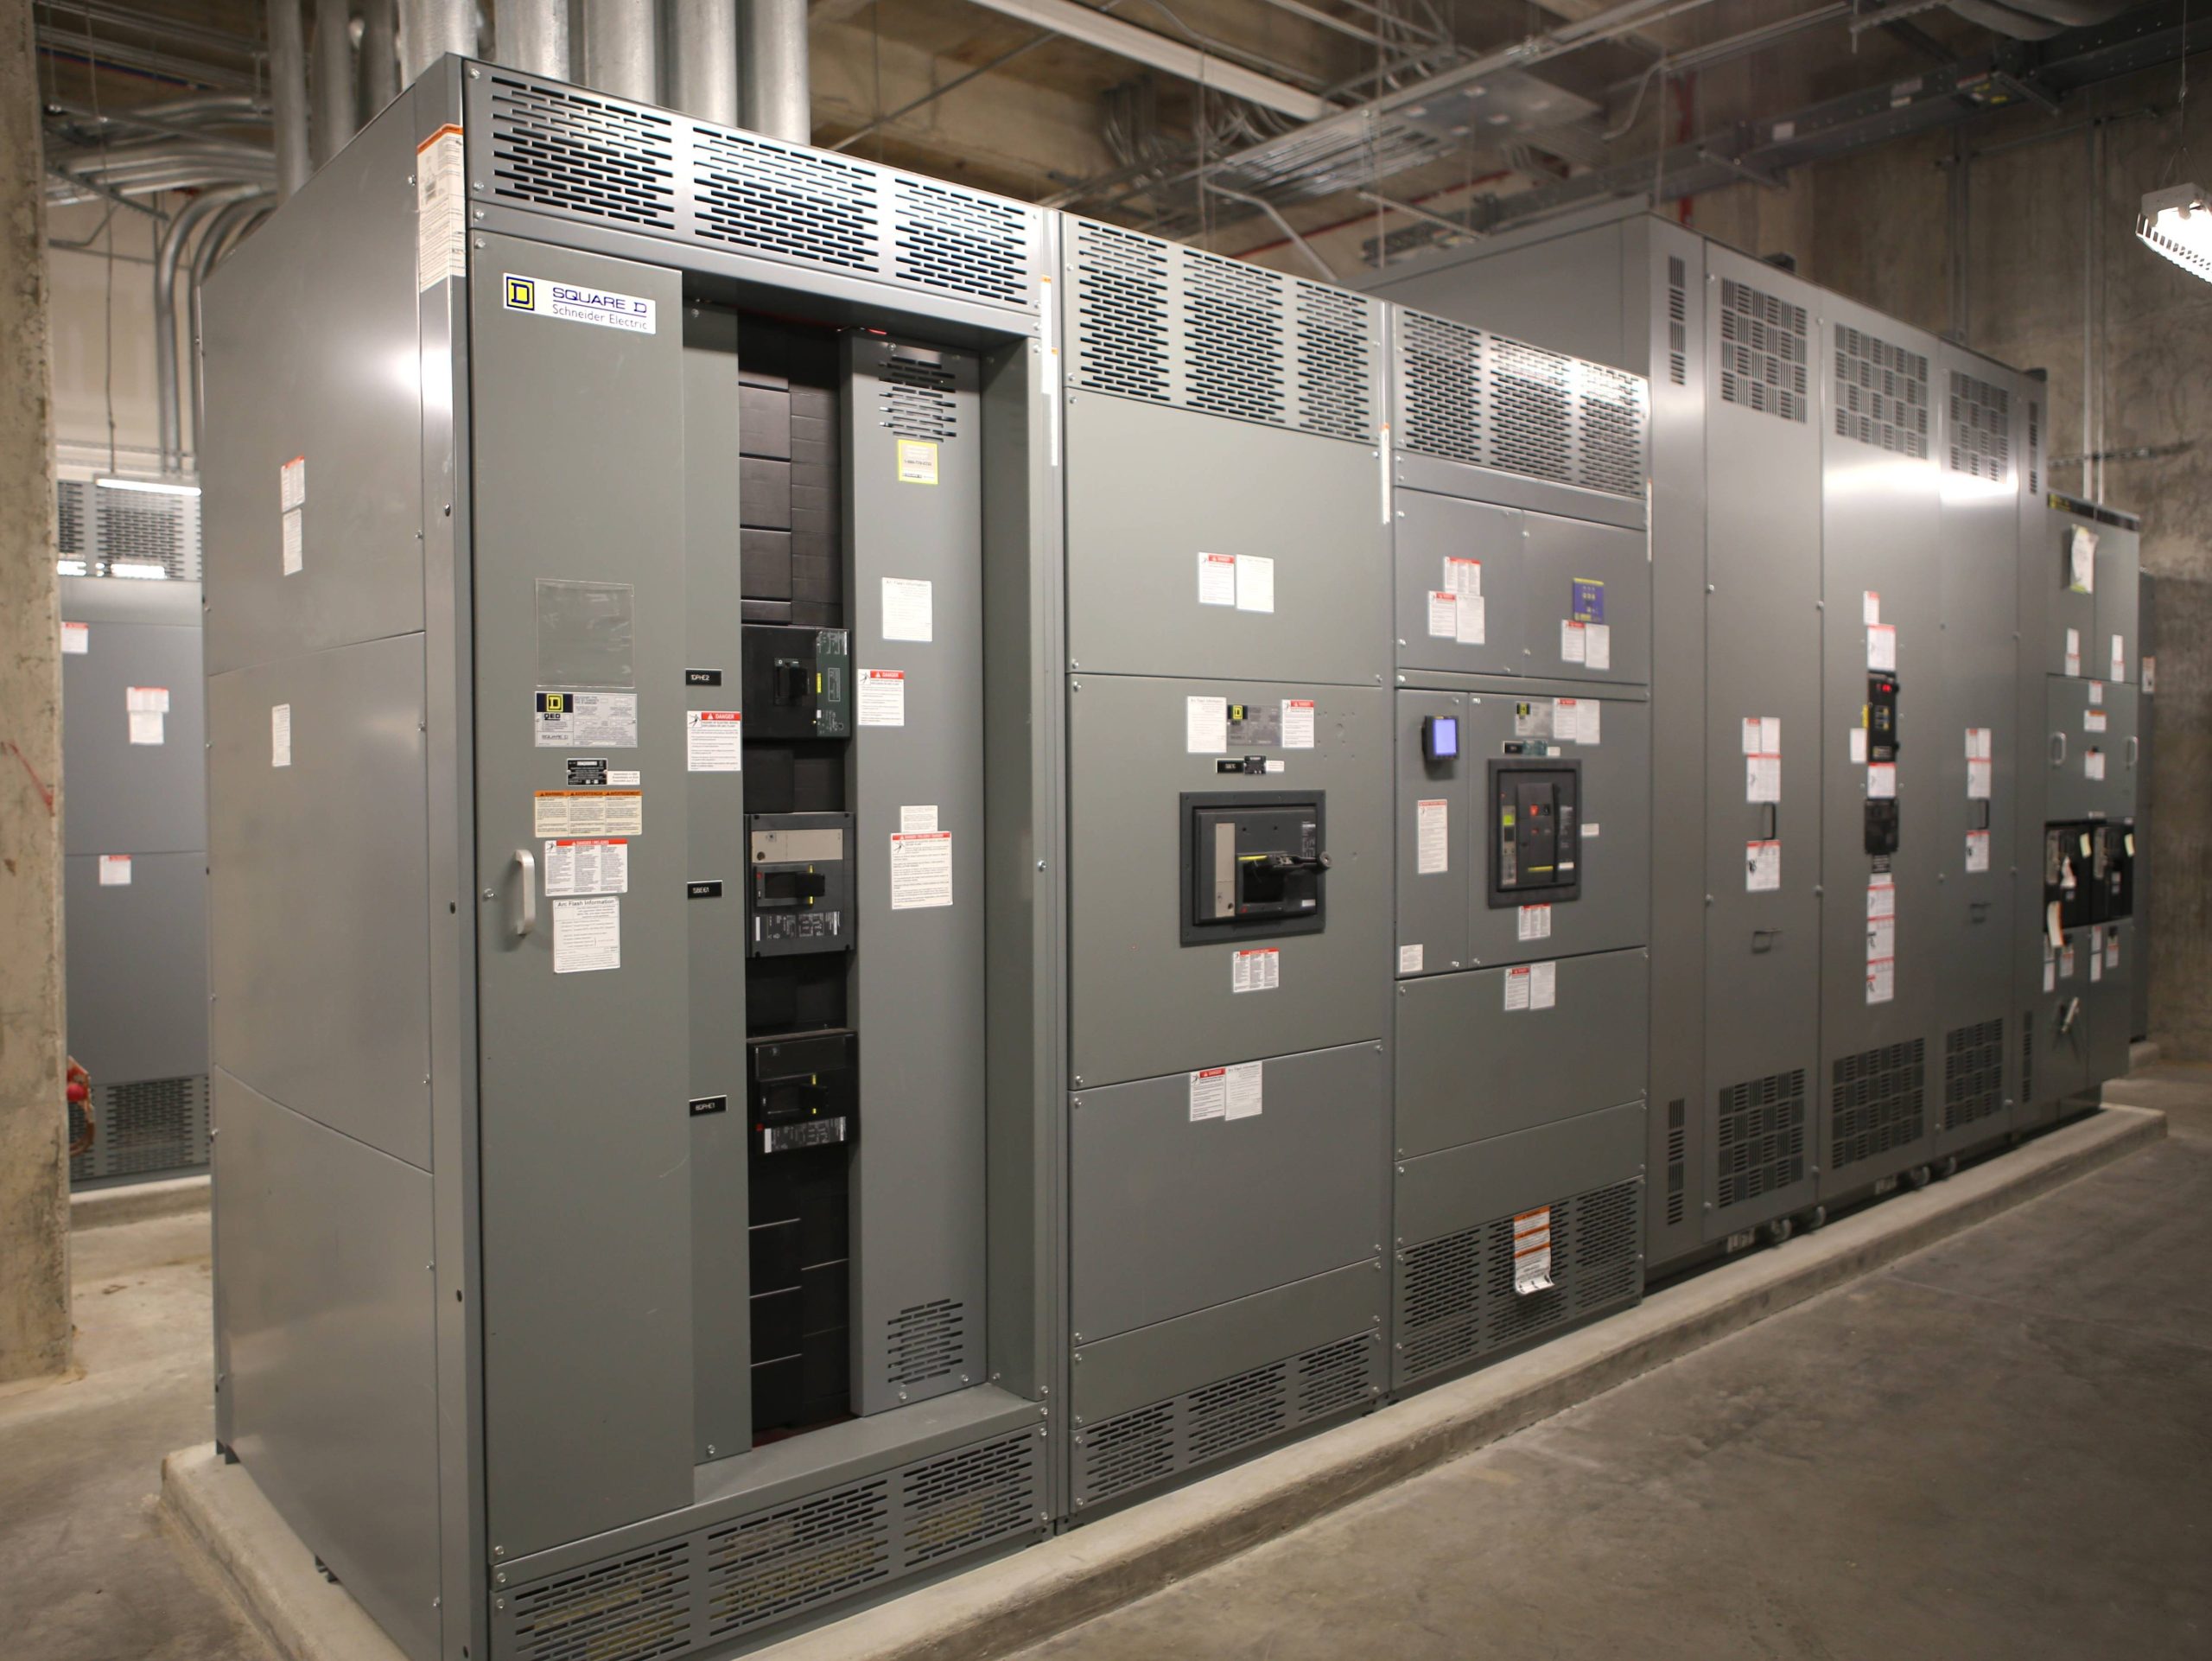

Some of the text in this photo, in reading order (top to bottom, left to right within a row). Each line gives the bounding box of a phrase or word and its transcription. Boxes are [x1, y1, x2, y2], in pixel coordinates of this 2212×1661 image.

[510, 281, 531, 306] D
[552, 287, 647, 314] SQUARE D
[552, 303, 648, 330] Schneider Electric
